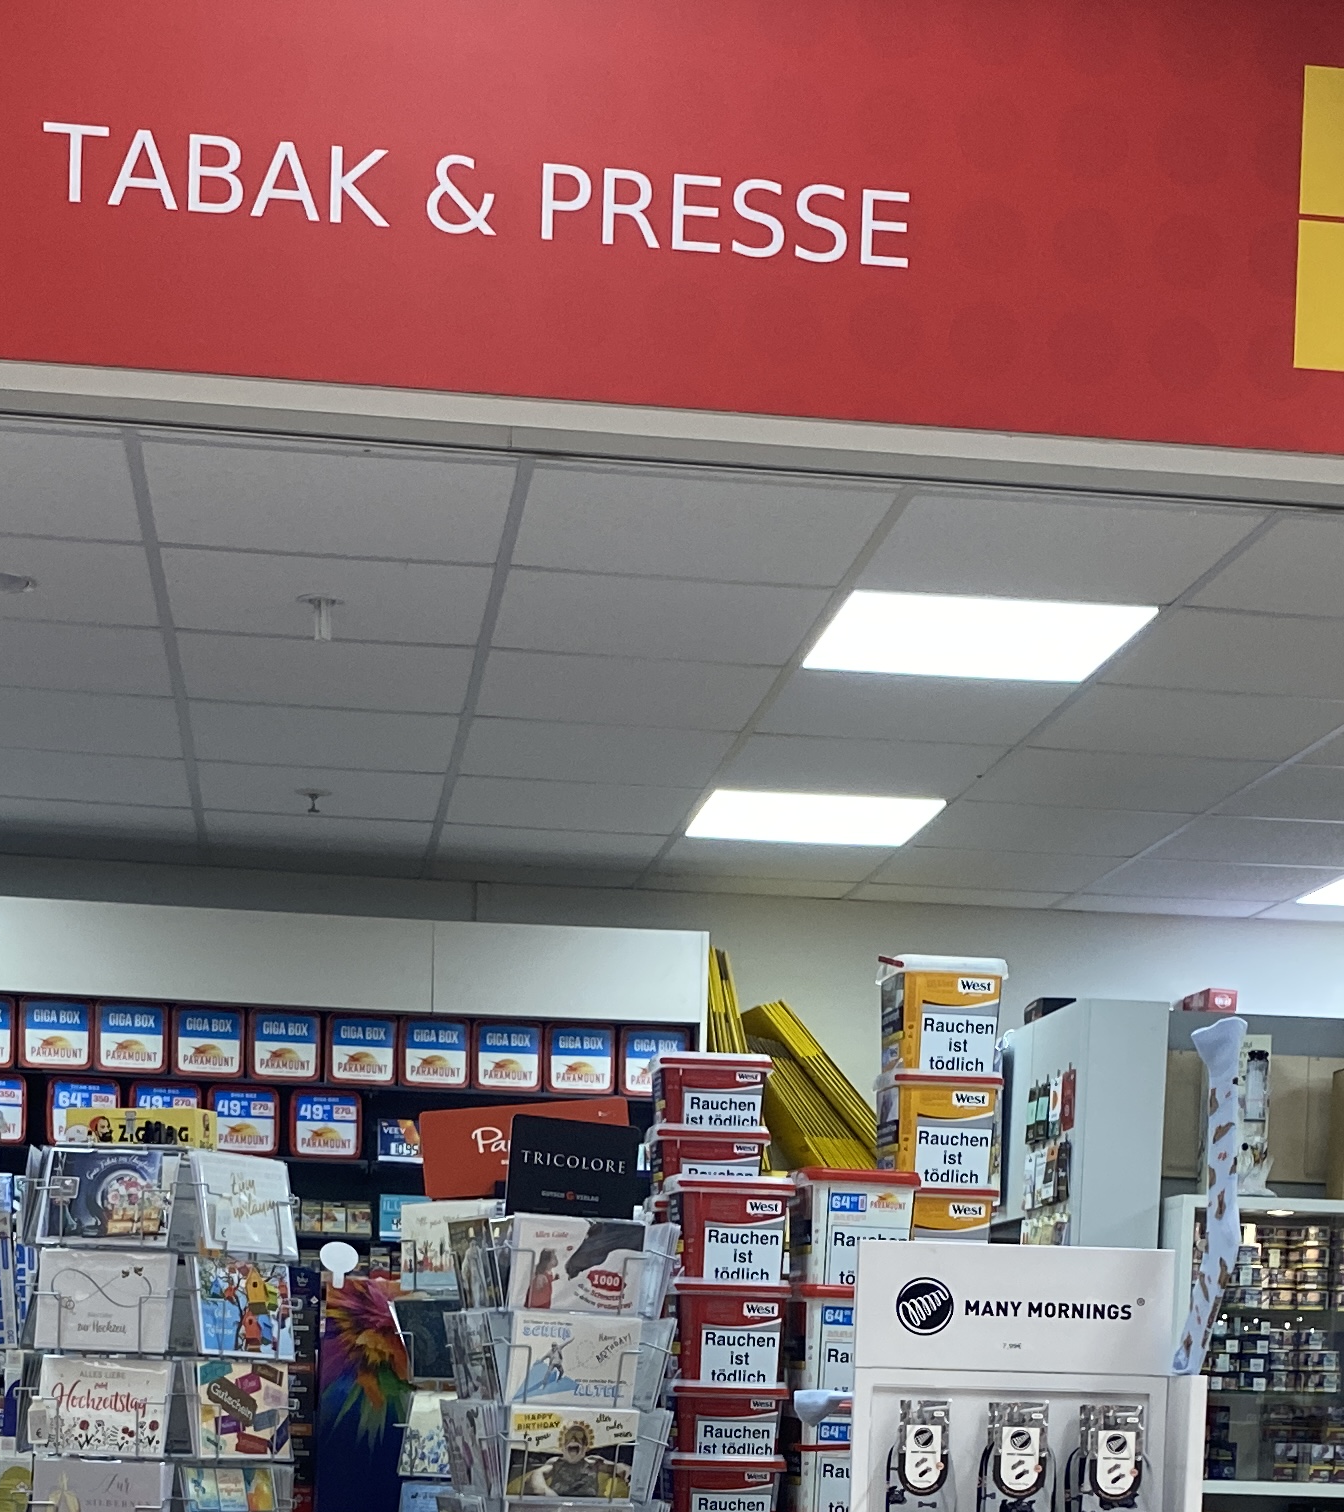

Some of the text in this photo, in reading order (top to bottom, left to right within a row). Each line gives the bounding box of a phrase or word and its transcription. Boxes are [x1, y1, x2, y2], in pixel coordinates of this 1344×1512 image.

[43, 121, 911, 268] TABAK & PRESSE
[960, 979, 992, 992] West
[33, 1008, 80, 1024] GIGA BOX
[923, 1017, 994, 1035] Rauchen
[30, 1046, 82, 1060] PARAMOUNT
[948, 1037, 968, 1053] ist
[929, 1056, 984, 1073] tödlich
[520, 1149, 627, 1175] TRICOLORE
[592, 1274, 620, 1287] 1000
[963, 1300, 1132, 1321] MANY MORNINGS
[51, 1380, 148, 1417] Hochzeitstag
[210, 1383, 254, 1421] Gutschein
